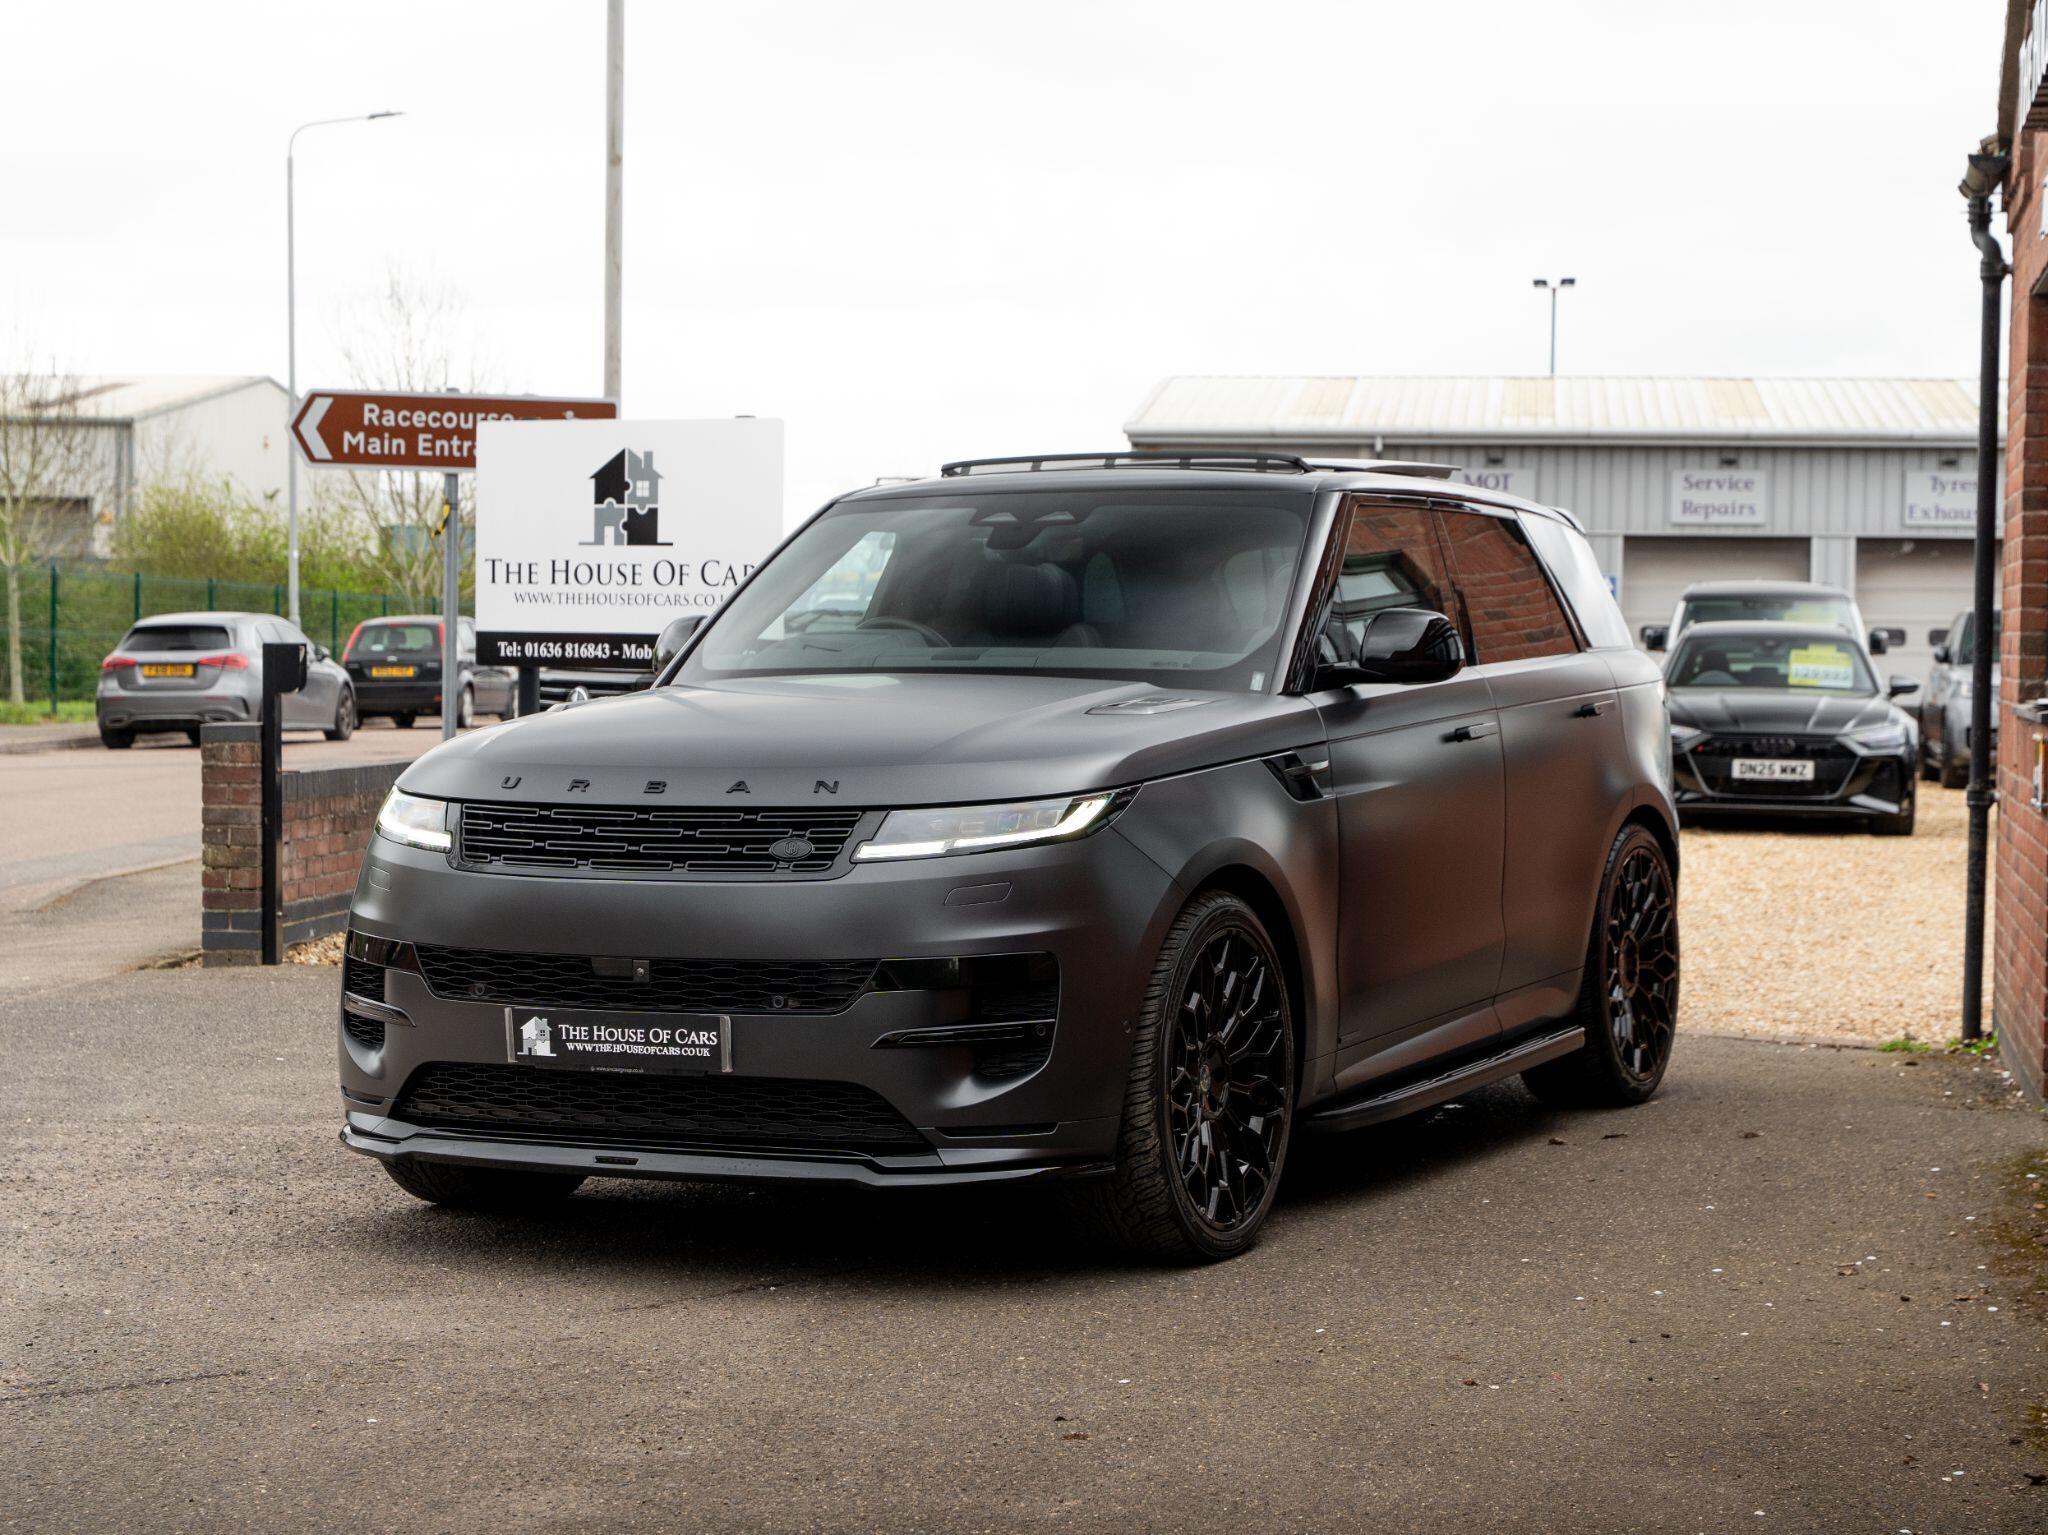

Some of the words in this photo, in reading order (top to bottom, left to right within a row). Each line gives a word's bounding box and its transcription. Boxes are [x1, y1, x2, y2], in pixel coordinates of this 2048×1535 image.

[343, 431, 406, 456] Main
[417, 433, 477, 458] Entr
[1683, 474, 1756, 492] Service
[1682, 499, 1757, 518] Repairs
[498, 641, 522, 658] Tel:
[525, 641, 562, 658] 01636
[565, 642, 610, 659] 816843
[500, 775, 841, 795] URBAN
